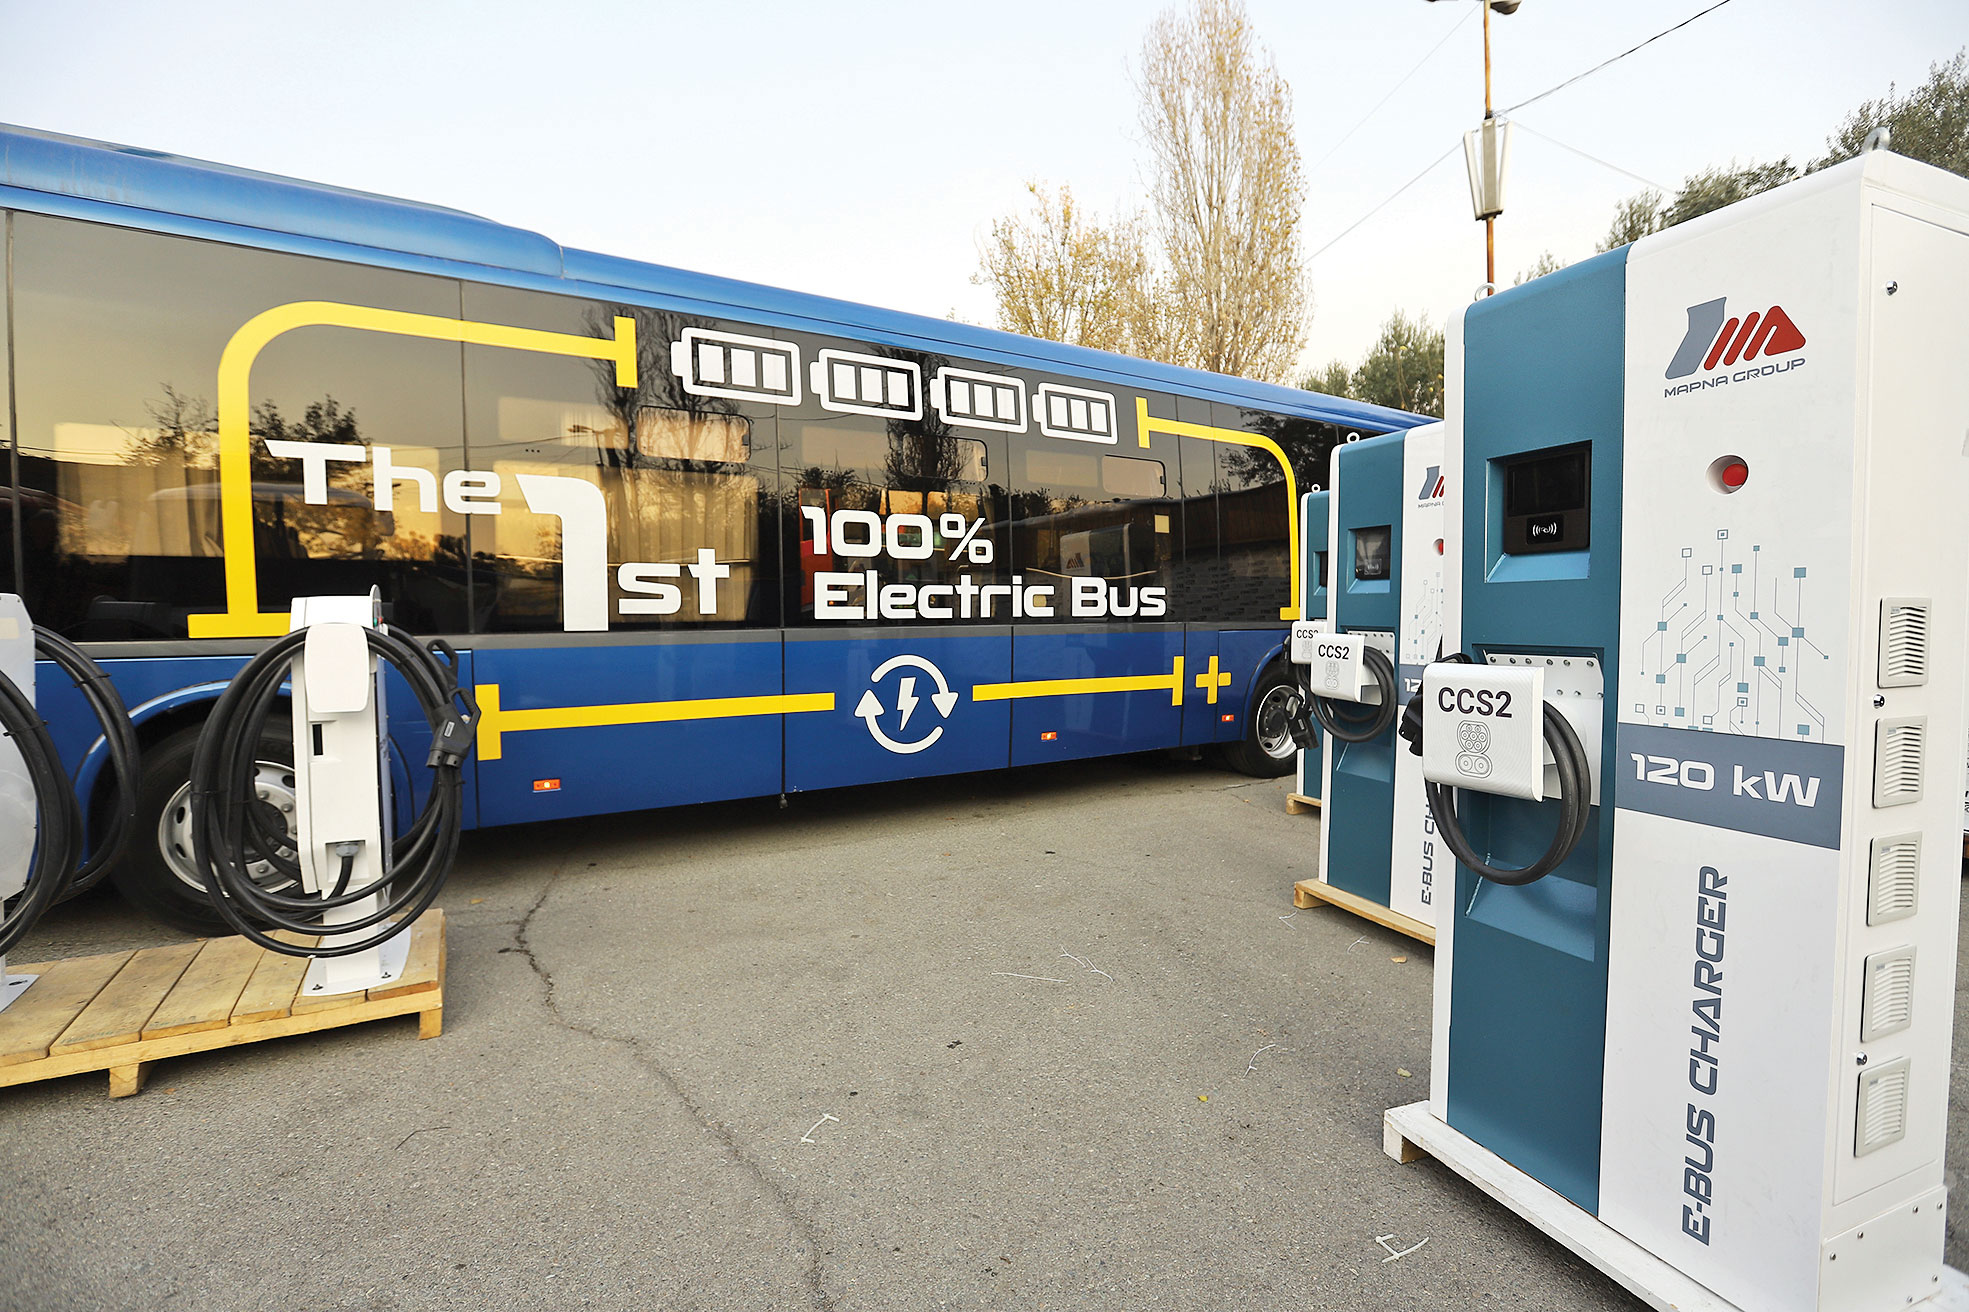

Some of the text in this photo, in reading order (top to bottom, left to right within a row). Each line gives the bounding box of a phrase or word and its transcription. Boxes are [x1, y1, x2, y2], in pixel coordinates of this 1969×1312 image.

[1664, 357, 1806, 398] MAPNA GROUP
[264, 439, 502, 514] The
[801, 506, 994, 564] 100%
[814, 570, 1054, 620] Electric
[1071, 576, 1166, 617] Bus
[1318, 644, 1350, 660] CCS2
[1438, 686, 1512, 719] CCS2
[1629, 752, 1822, 808] 120 kW
[1421, 840, 1434, 906] E-BUS
[1682, 864, 1729, 1247] E-BUS CHARGER
